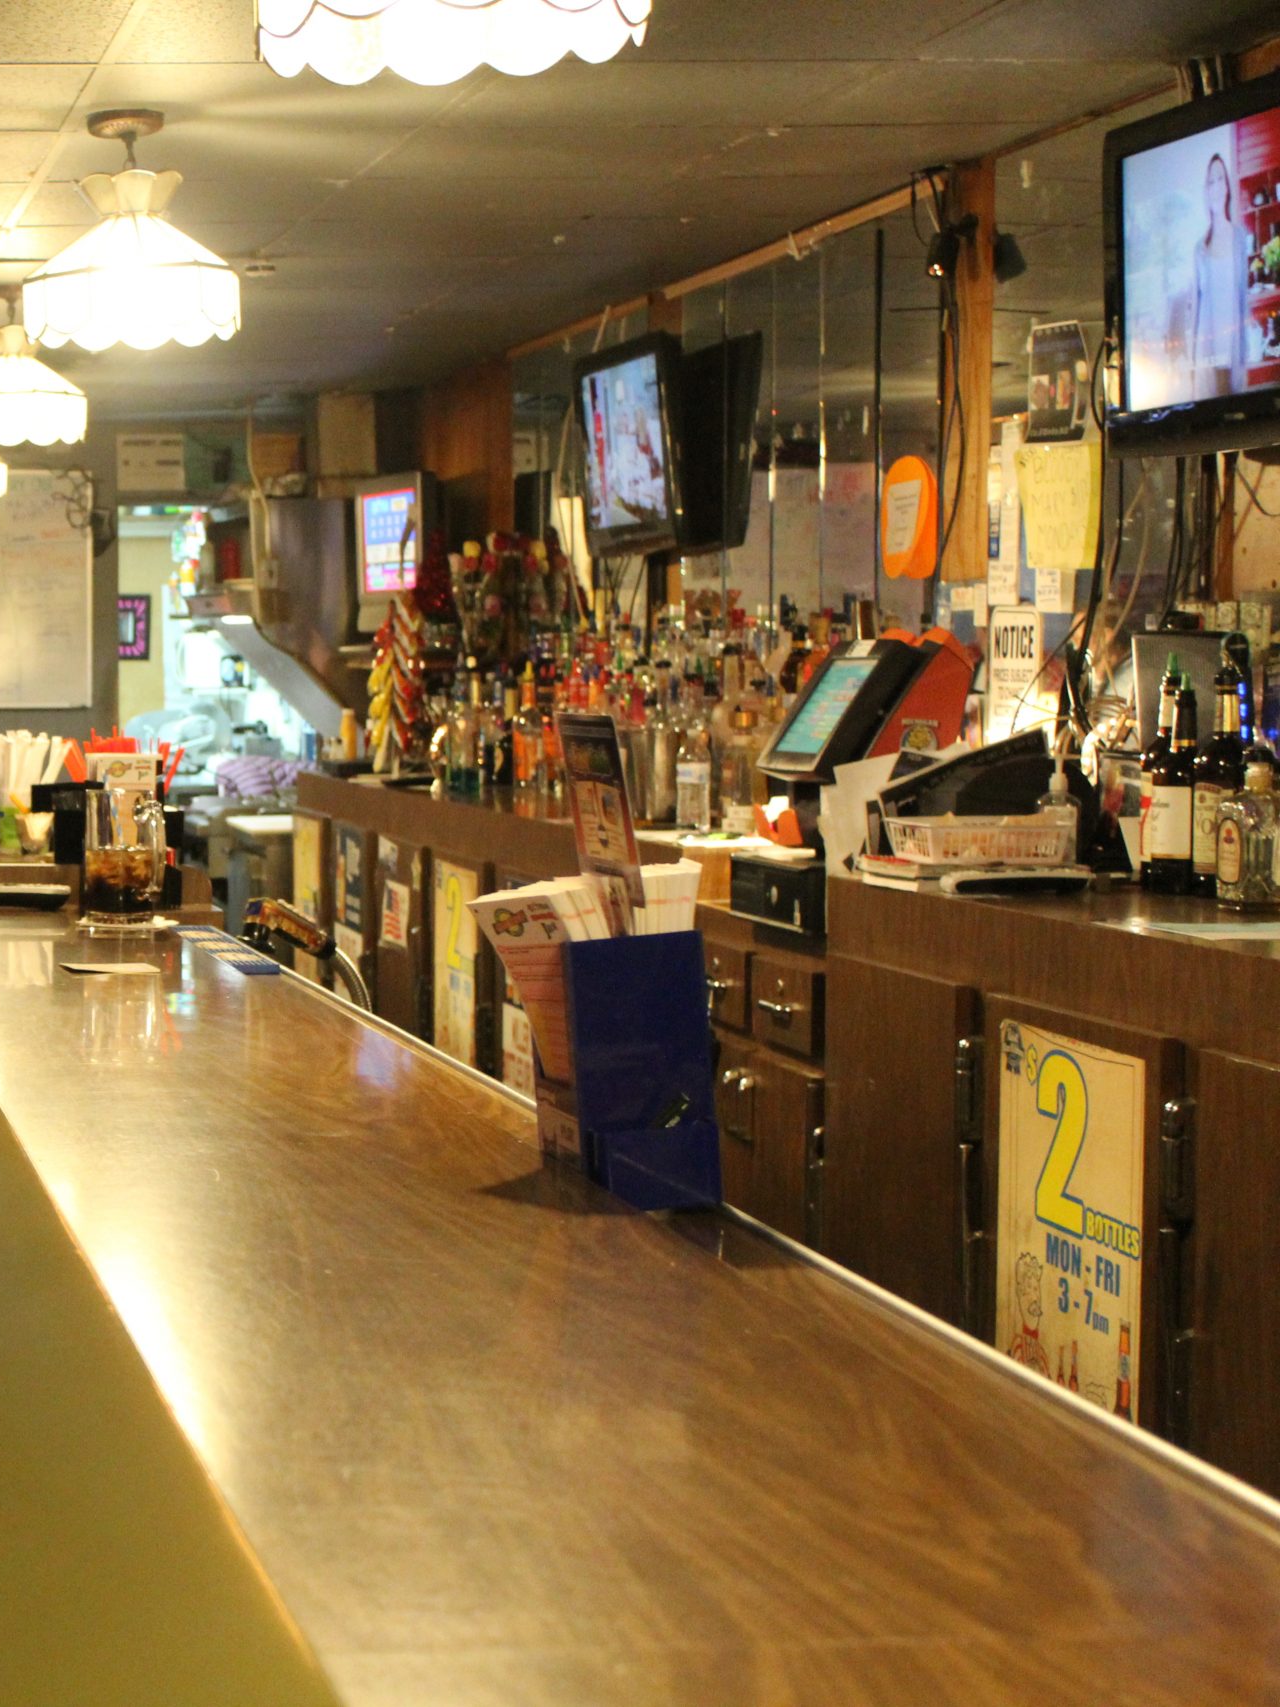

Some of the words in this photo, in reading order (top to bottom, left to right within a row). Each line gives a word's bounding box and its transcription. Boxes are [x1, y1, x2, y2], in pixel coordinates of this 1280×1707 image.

[994, 625, 1034, 659] NOTICE
[1085, 1207, 1140, 1260] BOTTLES
[1046, 1232, 1081, 1278] MON
[1095, 1254, 1120, 1297] FRI
[1058, 1277, 1069, 1314] 3
